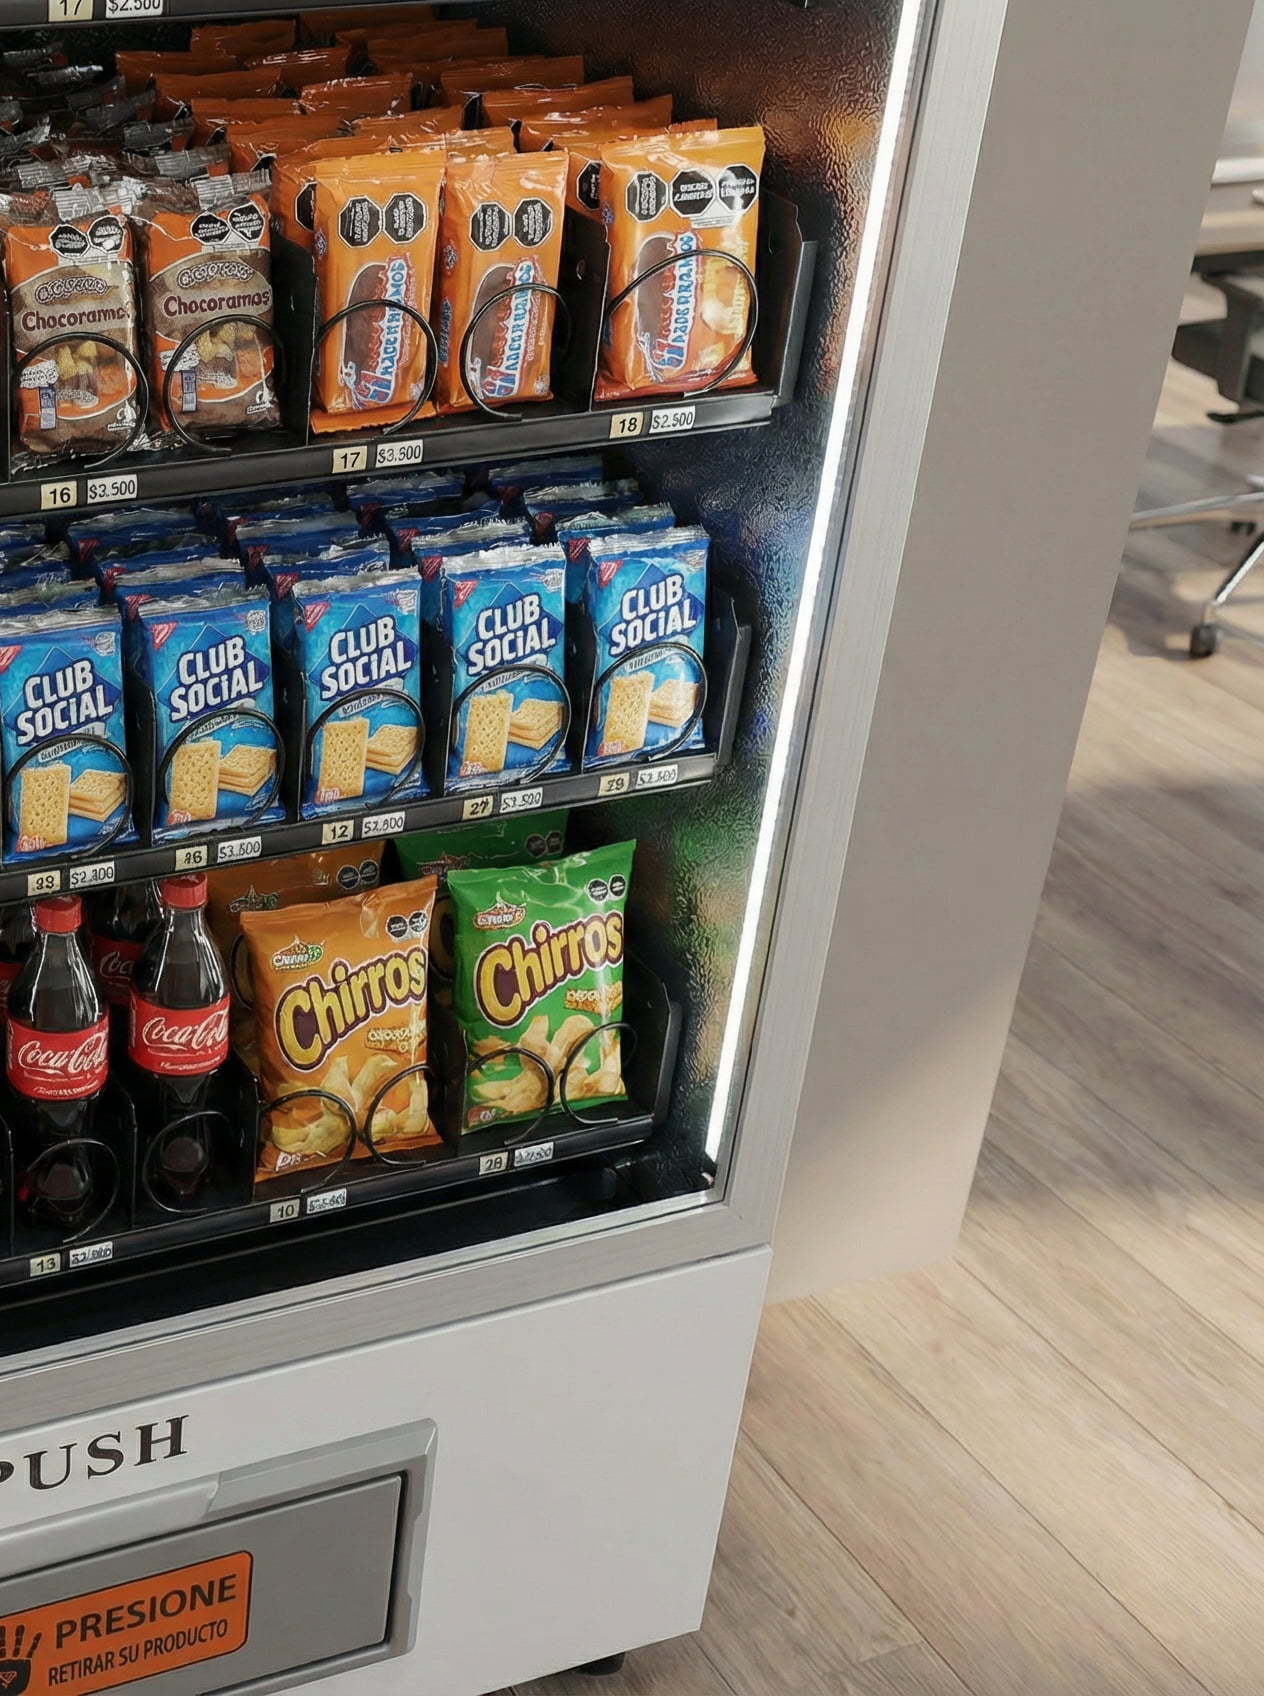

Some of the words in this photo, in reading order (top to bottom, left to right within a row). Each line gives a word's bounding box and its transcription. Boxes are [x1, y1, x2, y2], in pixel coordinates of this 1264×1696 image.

[58, 0, 83, 16] 17
[163, 290, 272, 318] Chocoramos
[618, 417, 638, 434] 18
[340, 451, 362, 470] 17
[48, 487, 71, 505] 16
[88, 480, 136, 499] $3.500
[477, 594, 541, 640] CLUB
[621, 574, 683, 621] CLUB
[177, 636, 245, 686] CLUB
[329, 616, 396, 665] CLUB
[23, 659, 94, 710] CLUB
[330, 824, 349, 840] 12
[478, 912, 623, 1021] Chirros
[277, 950, 427, 1066] Chirros
[36, 1257, 57, 1274] 13
[54, 1573, 238, 1650] PRESIONE
[47, 1651, 115, 1687] RETIRAR
[118, 1643, 140, 1667] SU
[143, 1618, 229, 1661] PRODUCTO
